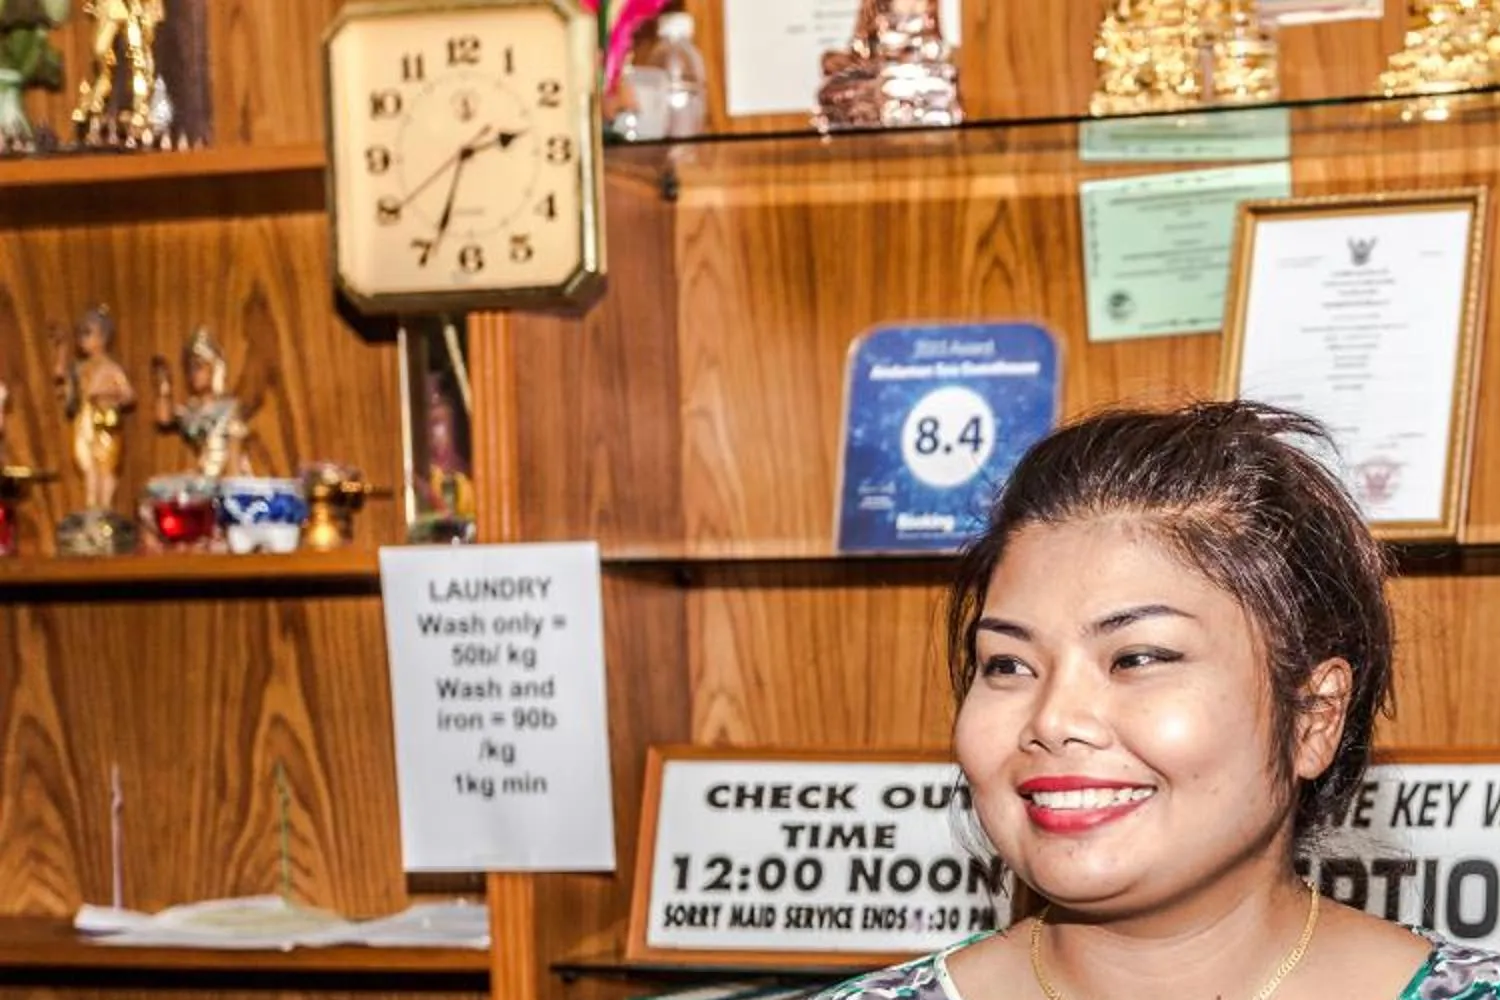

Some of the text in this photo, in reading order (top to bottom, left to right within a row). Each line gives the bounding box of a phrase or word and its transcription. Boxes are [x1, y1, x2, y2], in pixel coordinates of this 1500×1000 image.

[447, 35, 480, 66] 12
[504, 48, 514, 74] 1
[402, 50, 424, 81] 11
[370, 91, 402, 119] 10
[537, 81, 560, 107] 2
[365, 146, 390, 173] 9
[547, 137, 571, 164] 3
[534, 195, 557, 221] 4
[410, 239, 432, 267] 7
[459, 245, 484, 272] 6
[509, 235, 533, 262] 5
[915, 415, 983, 455] 8.4
[429, 577, 552, 601] LAUNDRY
[418, 613, 485, 637] Wash
[492, 612, 545, 640] only
[508, 643, 538, 668] kg
[436, 677, 556, 700] Wash and
[437, 710, 484, 731] iron
[513, 707, 558, 730] 90b
[455, 774, 548, 799] 1kg min
[706, 784, 857, 810] CHECK
[1390, 781, 1470, 828] KEY
[781, 824, 897, 849] TIME
[672, 856, 1003, 894] 12:00 NOON
[664, 905, 721, 928] SORRY
[729, 905, 777, 929] MAID
[785, 905, 854, 930] SERVICE
[862, 906, 907, 930] ENDS
